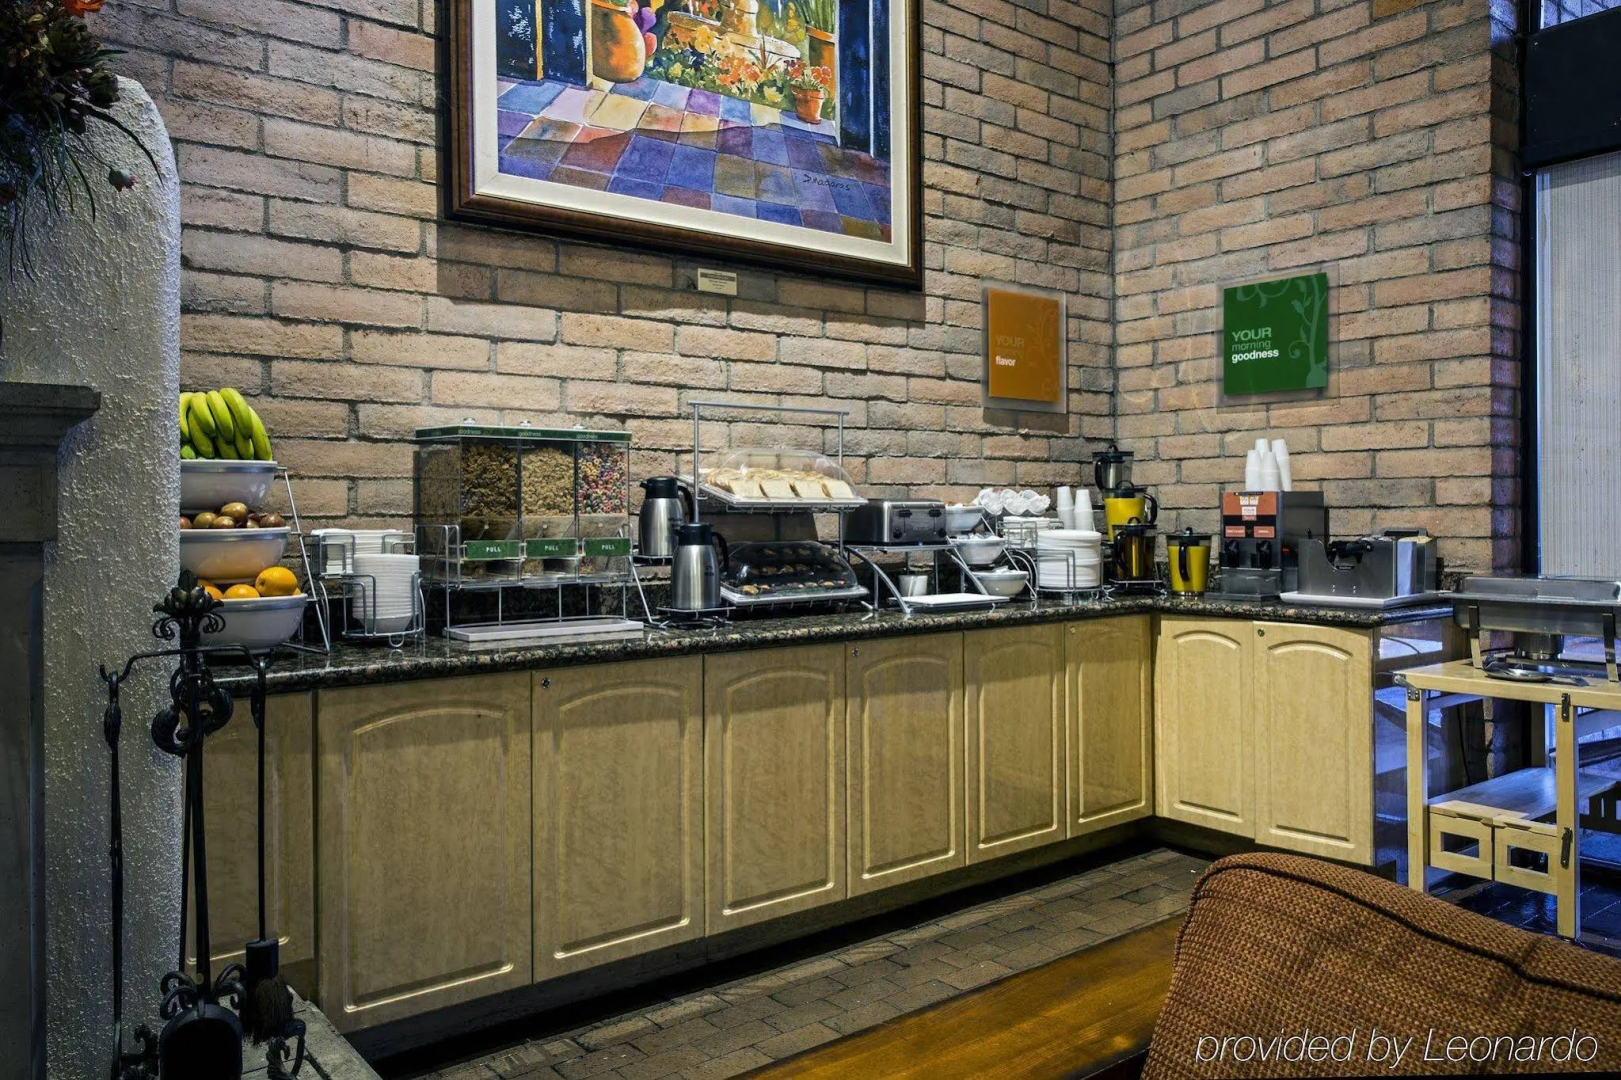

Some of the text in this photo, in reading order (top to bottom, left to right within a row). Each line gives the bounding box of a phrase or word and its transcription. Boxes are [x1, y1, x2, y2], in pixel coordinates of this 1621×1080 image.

[1232, 327, 1272, 341] YOUR
[995, 335, 1025, 348] YOUR
[1232, 340, 1271, 351] morning
[995, 355, 1016, 366] flavor
[1231, 350, 1279, 363] goodness
